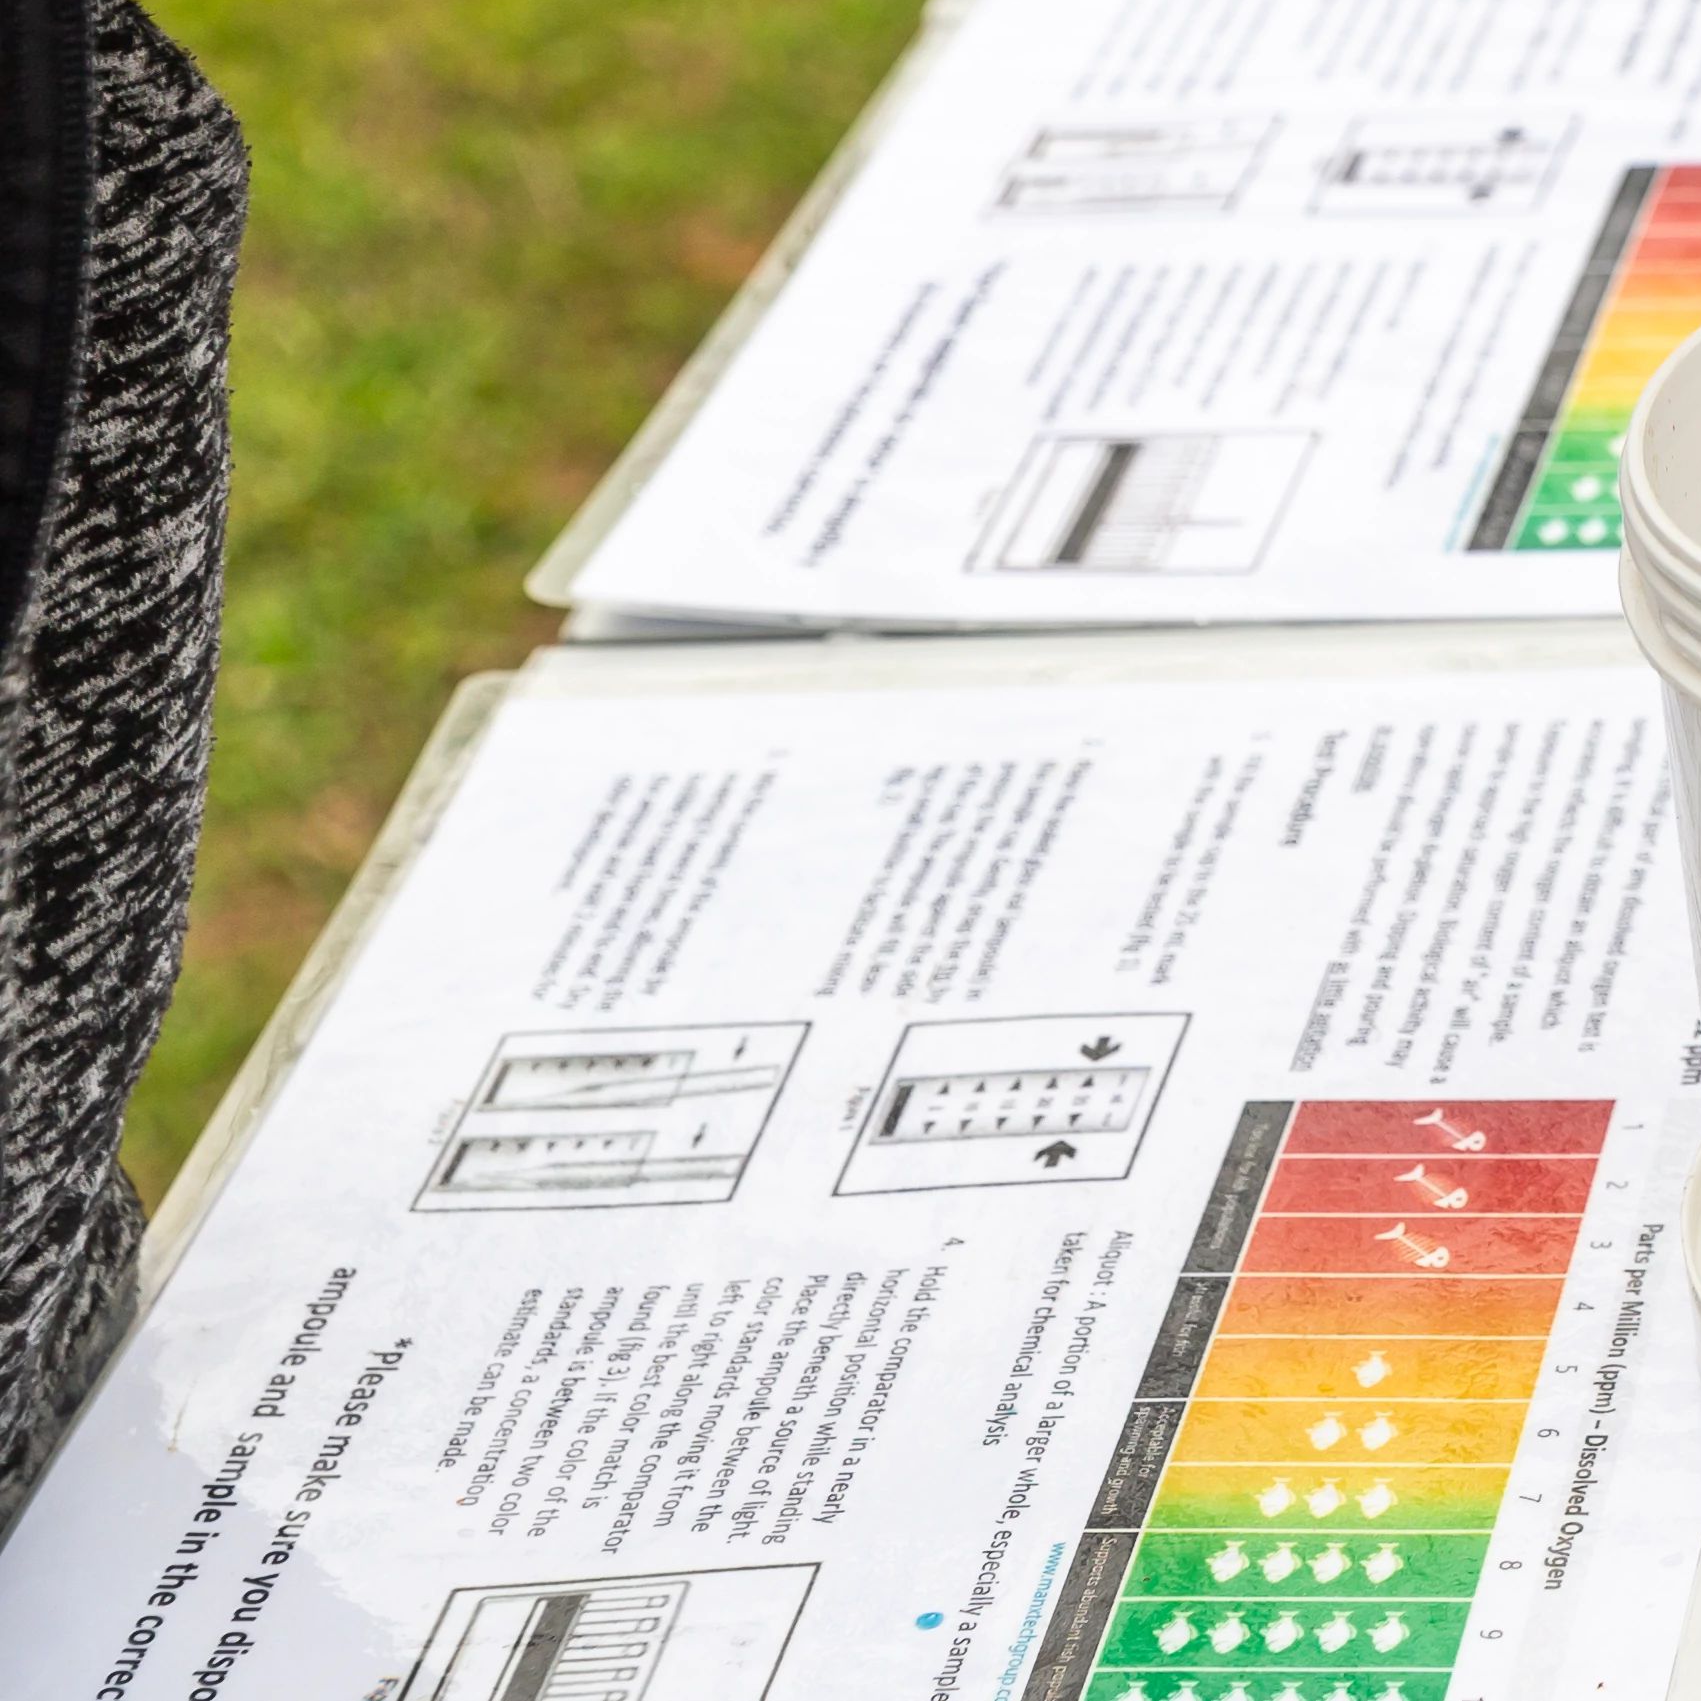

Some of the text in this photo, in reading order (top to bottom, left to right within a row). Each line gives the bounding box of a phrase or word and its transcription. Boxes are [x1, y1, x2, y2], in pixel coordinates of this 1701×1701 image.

[1605, 1181, 1629, 1190] 2
[1589, 1241, 1613, 1250] 3
[494, 1288, 543, 1358] estimate
[627, 1285, 671, 1332] found
[1573, 1302, 1595, 1311] 4
[607, 1337, 646, 1363] (fig
[982, 1232, 1086, 1447] taken for chemical analysis
[1554, 1365, 1579, 1374] 5
[458, 1288, 584, 1507] standards, concentration
[476, 1363, 505, 1391] can
[590, 1283, 703, 1491] until the best color match
[652, 1277, 784, 1528] color standards moving from
[690, 1274, 830, 1533] Place the ampoule between the
[761, 1268, 910, 1546] horizontal position while standing
[811, 1266, 948, 1524] Hold the comparator nearly
[1543, 1224, 1665, 1590] Parts per Million (ppm) Dissolved Oxygen
[488, 1287, 624, 1536] ampoule between two color
[576, 1408, 609, 1435] the
[600, 1280, 751, 1555] left right along the comparator
[726, 1272, 867, 1544] directly beneath source light.
[1536, 1428, 1560, 1439] 6
[95, 1268, 357, 1701] ampoule and sample the correc
[295, 1436, 351, 1502] make
[555, 1439, 589, 1482] color
[930, 1230, 1134, 1701] Aliquot A portion larger whole, especially sample
[526, 1508, 560, 1538] the
[1518, 1494, 1543, 1504] 7
[260, 1510, 311, 1566] sure
[1498, 1560, 1523, 1571] 8
[230, 1573, 280, 1623] you
[1479, 1629, 1504, 1640] 9
[188, 1631, 255, 1701] dispo
